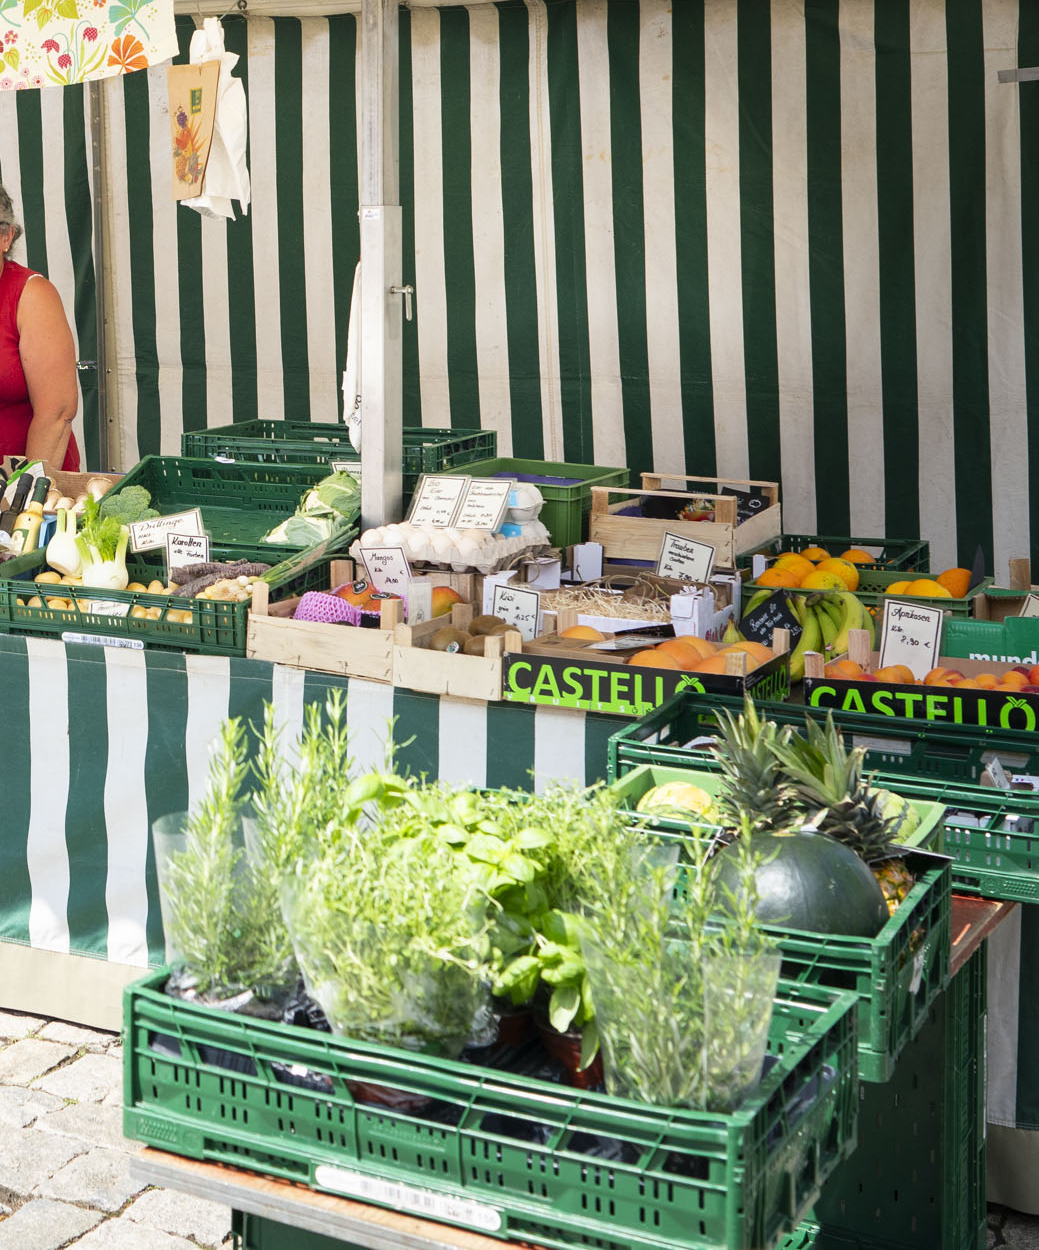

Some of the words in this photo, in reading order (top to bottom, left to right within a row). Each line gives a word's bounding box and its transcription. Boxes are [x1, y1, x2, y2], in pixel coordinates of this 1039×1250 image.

[172, 536, 202, 548] Karotten
[369, 552, 394, 566] Mangos
[890, 607, 931, 623] Aprikosen
